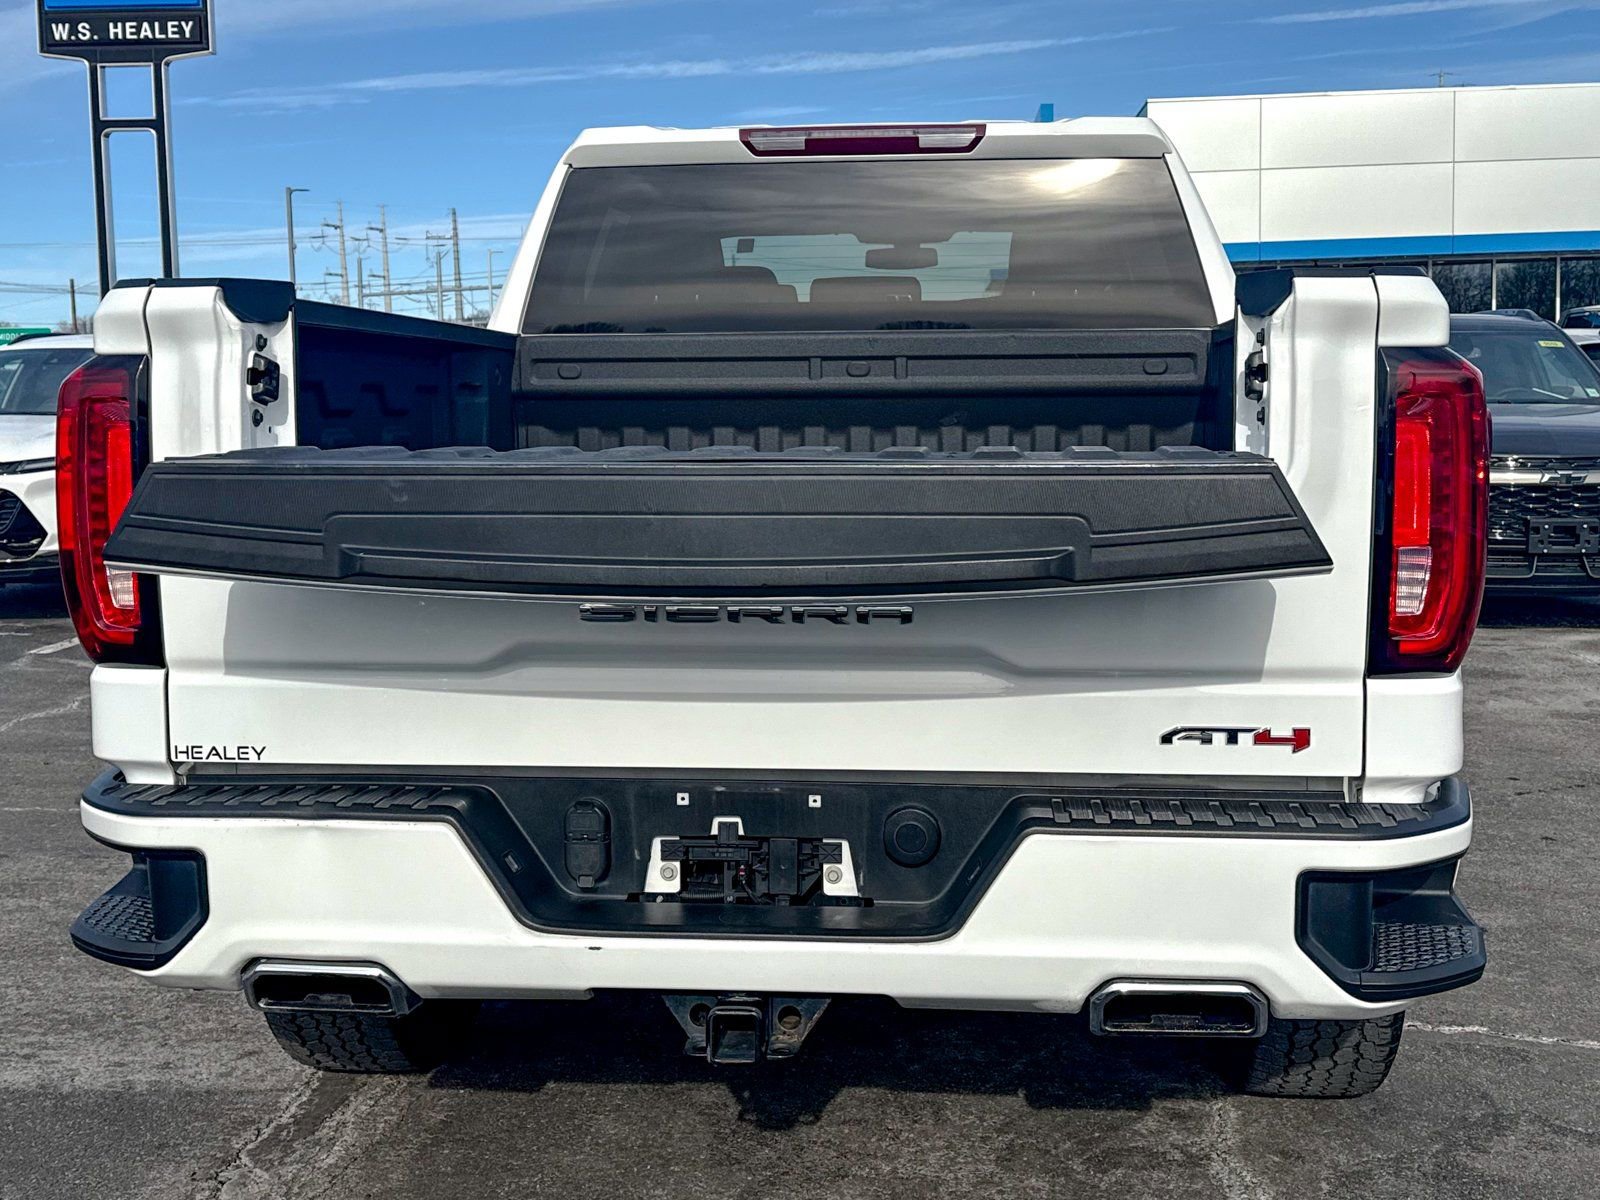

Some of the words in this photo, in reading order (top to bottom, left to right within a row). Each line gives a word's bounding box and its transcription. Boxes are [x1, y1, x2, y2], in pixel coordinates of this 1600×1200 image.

[51, 23, 98, 40] W.S.
[109, 21, 194, 39] HEALEY
[579, 603, 914, 625] SIERRA
[1160, 726, 1311, 754] AT4
[174, 745, 266, 760] HEALEY
